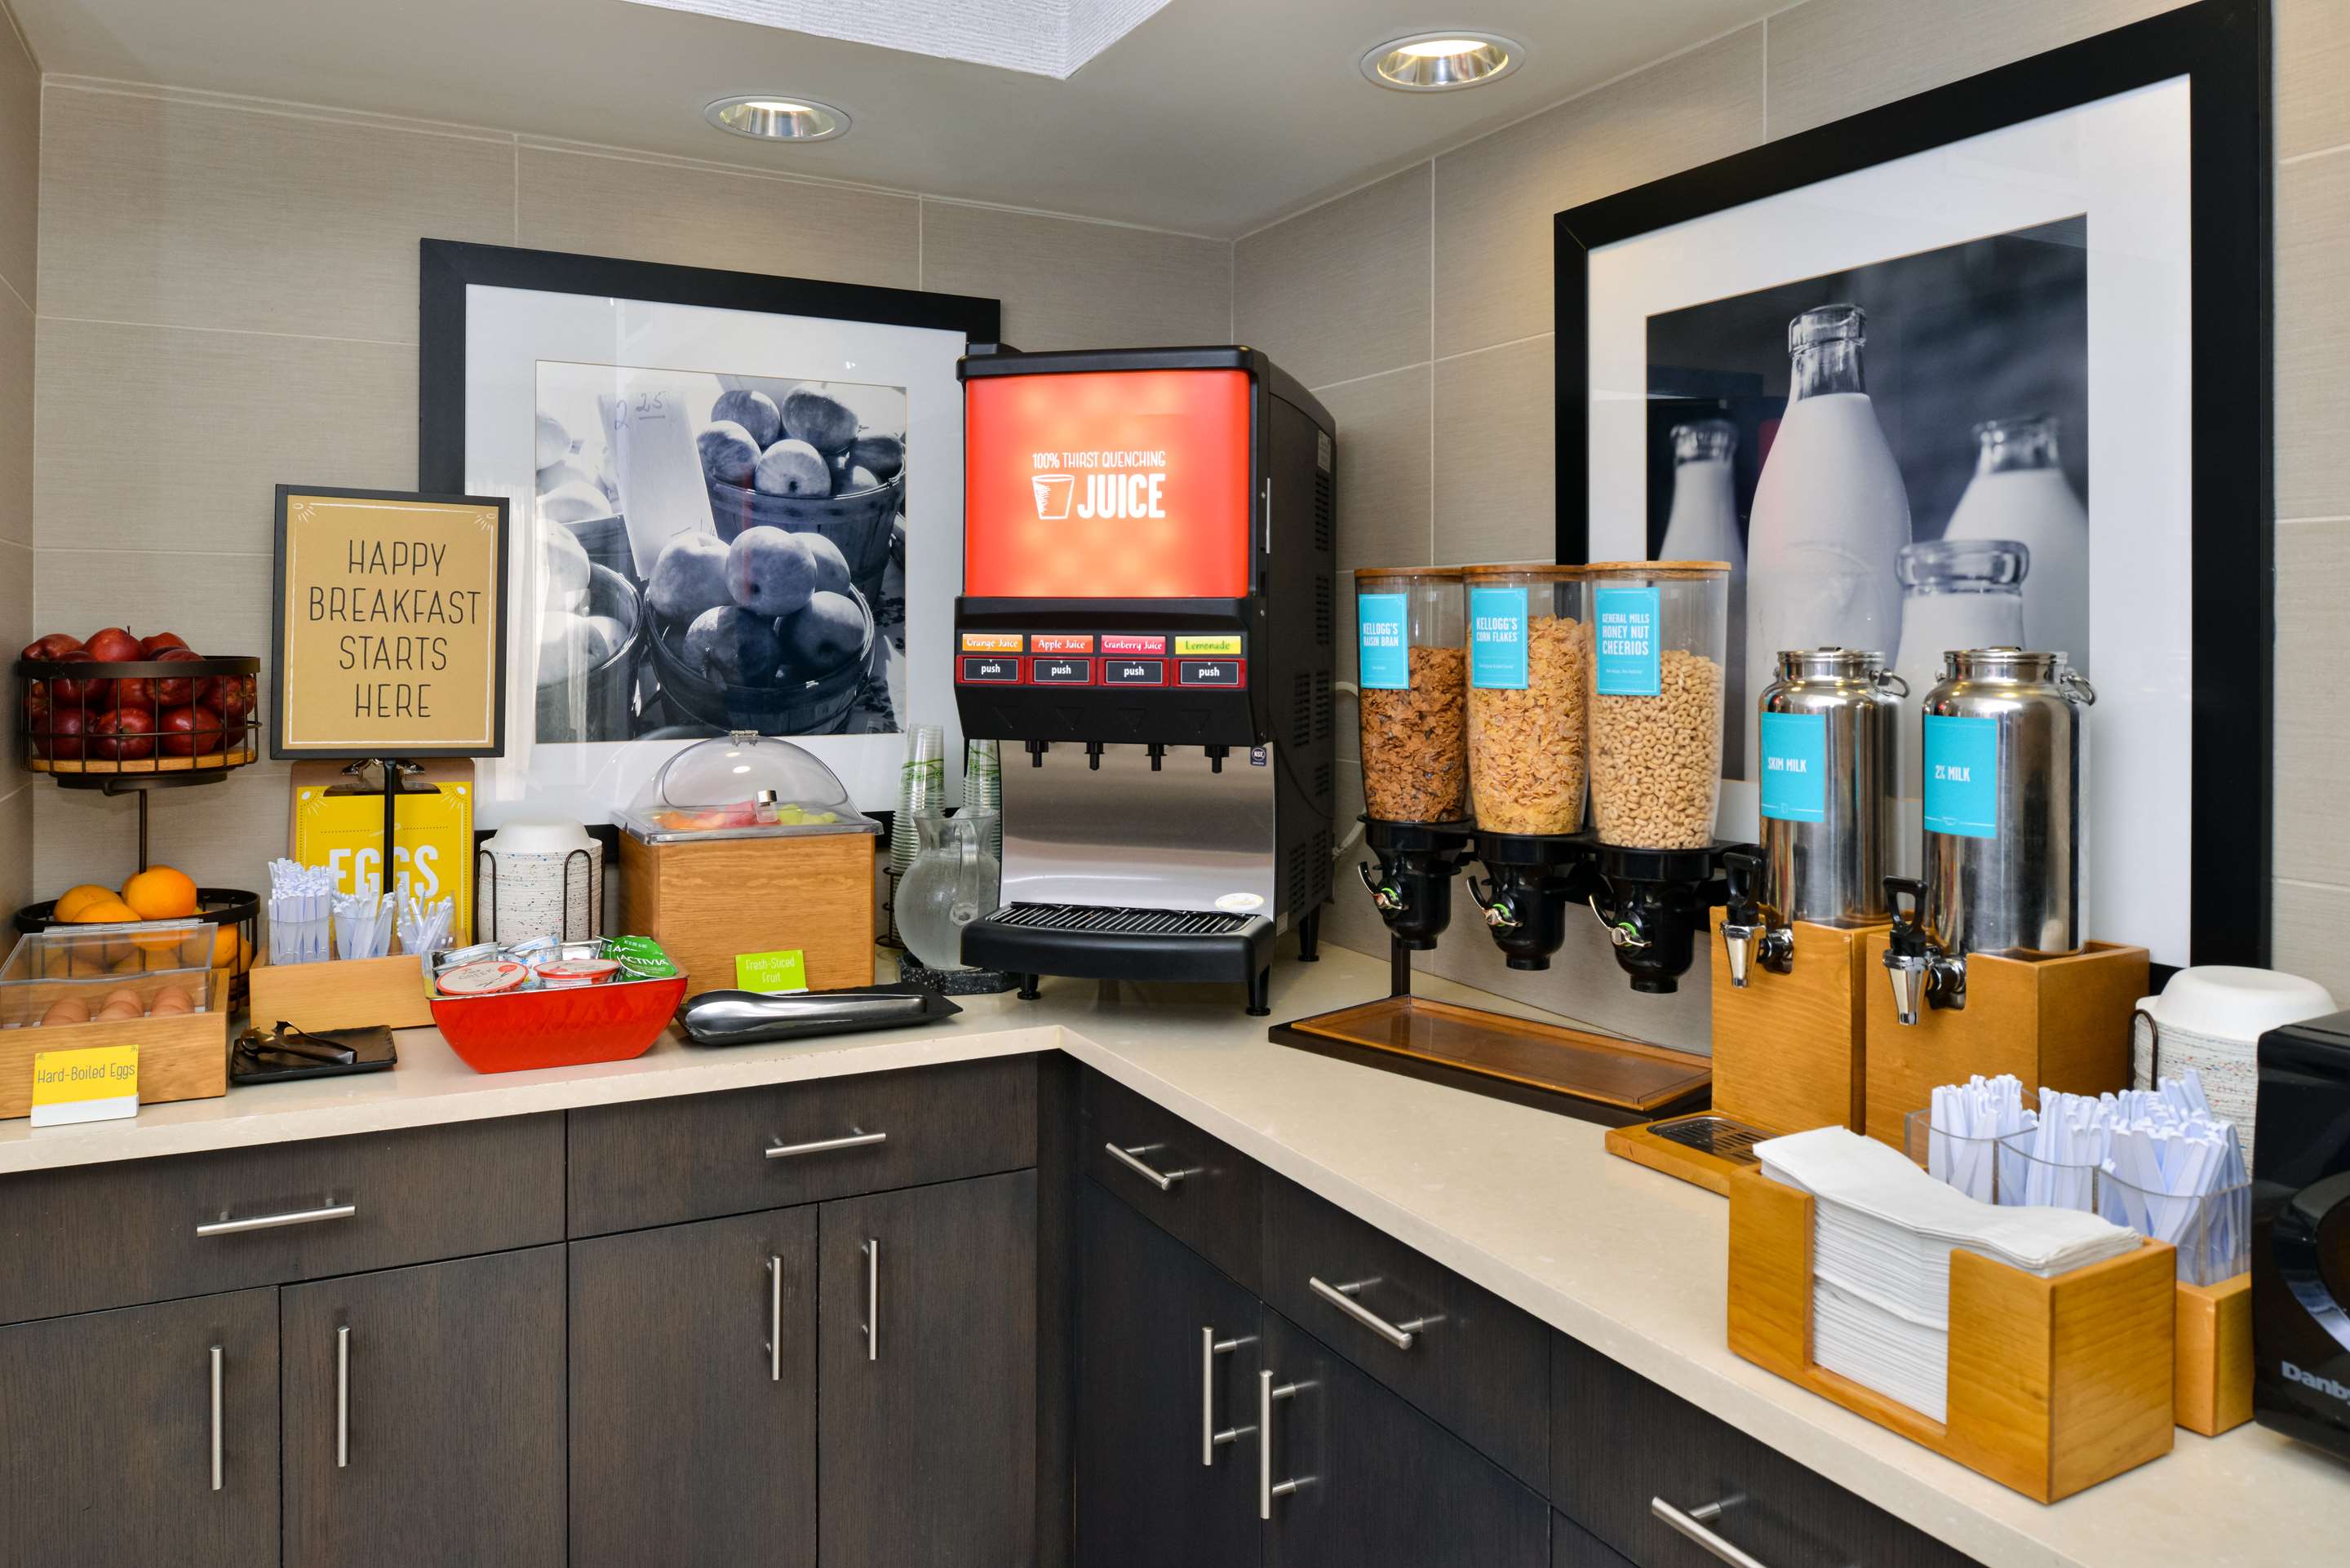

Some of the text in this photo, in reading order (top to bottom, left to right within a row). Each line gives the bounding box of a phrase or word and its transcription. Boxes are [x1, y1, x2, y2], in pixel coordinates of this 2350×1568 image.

[1032, 451, 1166, 468] 100% THIRST QUENCHING
[1077, 473, 1166, 519] JUICE
[348, 539, 446, 576] HAPPY
[309, 587, 481, 624] BREAKFAST
[1476, 617, 1518, 631] KELLOGG'S
[1602, 613, 1650, 623] GENERAL MILLS
[1363, 622, 1398, 635] KELLOGG'S
[1602, 626, 1649, 639] HONEY NUT
[1363, 636, 1399, 647] RAISIN BRAN
[1476, 631, 1518, 642] CORN FLAKES
[966, 639, 1019, 649] Orange Juice
[1038, 640, 1086, 651] Apple Juice
[1104, 640, 1163, 650] Cranberry Juice
[1186, 640, 1230, 650] Lemonade
[1602, 640, 1649, 656] CHEERIOS
[339, 636, 447, 671] STARTS
[981, 665, 1001, 675] push
[1051, 666, 1071, 676] push
[1124, 667, 1145, 678] push
[1199, 667, 1221, 679] push
[355, 684, 432, 717] HERE
[1767, 757, 1807, 773] SKIM MILK
[1935, 765, 1971, 782] 2% MILK
[746, 957, 795, 970] Fresh-Sliced
[762, 972, 782, 983] Fruit
[38, 1063, 135, 1083] Hard-Boiled Eggs
[2281, 1360, 2350, 1406] Danb
